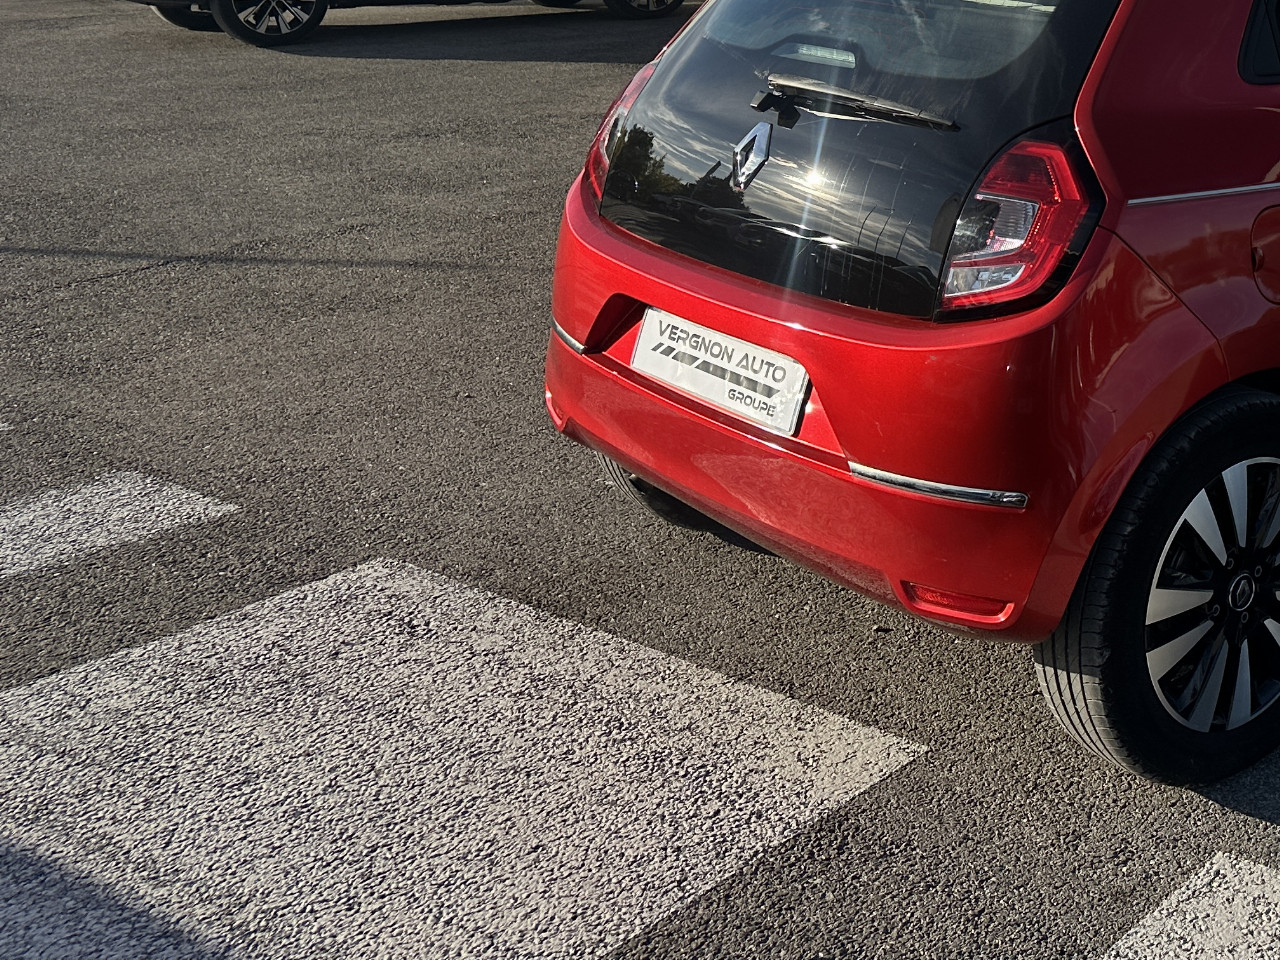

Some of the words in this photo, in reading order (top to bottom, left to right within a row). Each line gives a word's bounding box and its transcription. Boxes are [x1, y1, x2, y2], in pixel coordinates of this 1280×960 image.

[658, 319, 735, 364] VERGNON
[736, 352, 787, 383] AUTO
[727, 389, 777, 418] GROUPE
